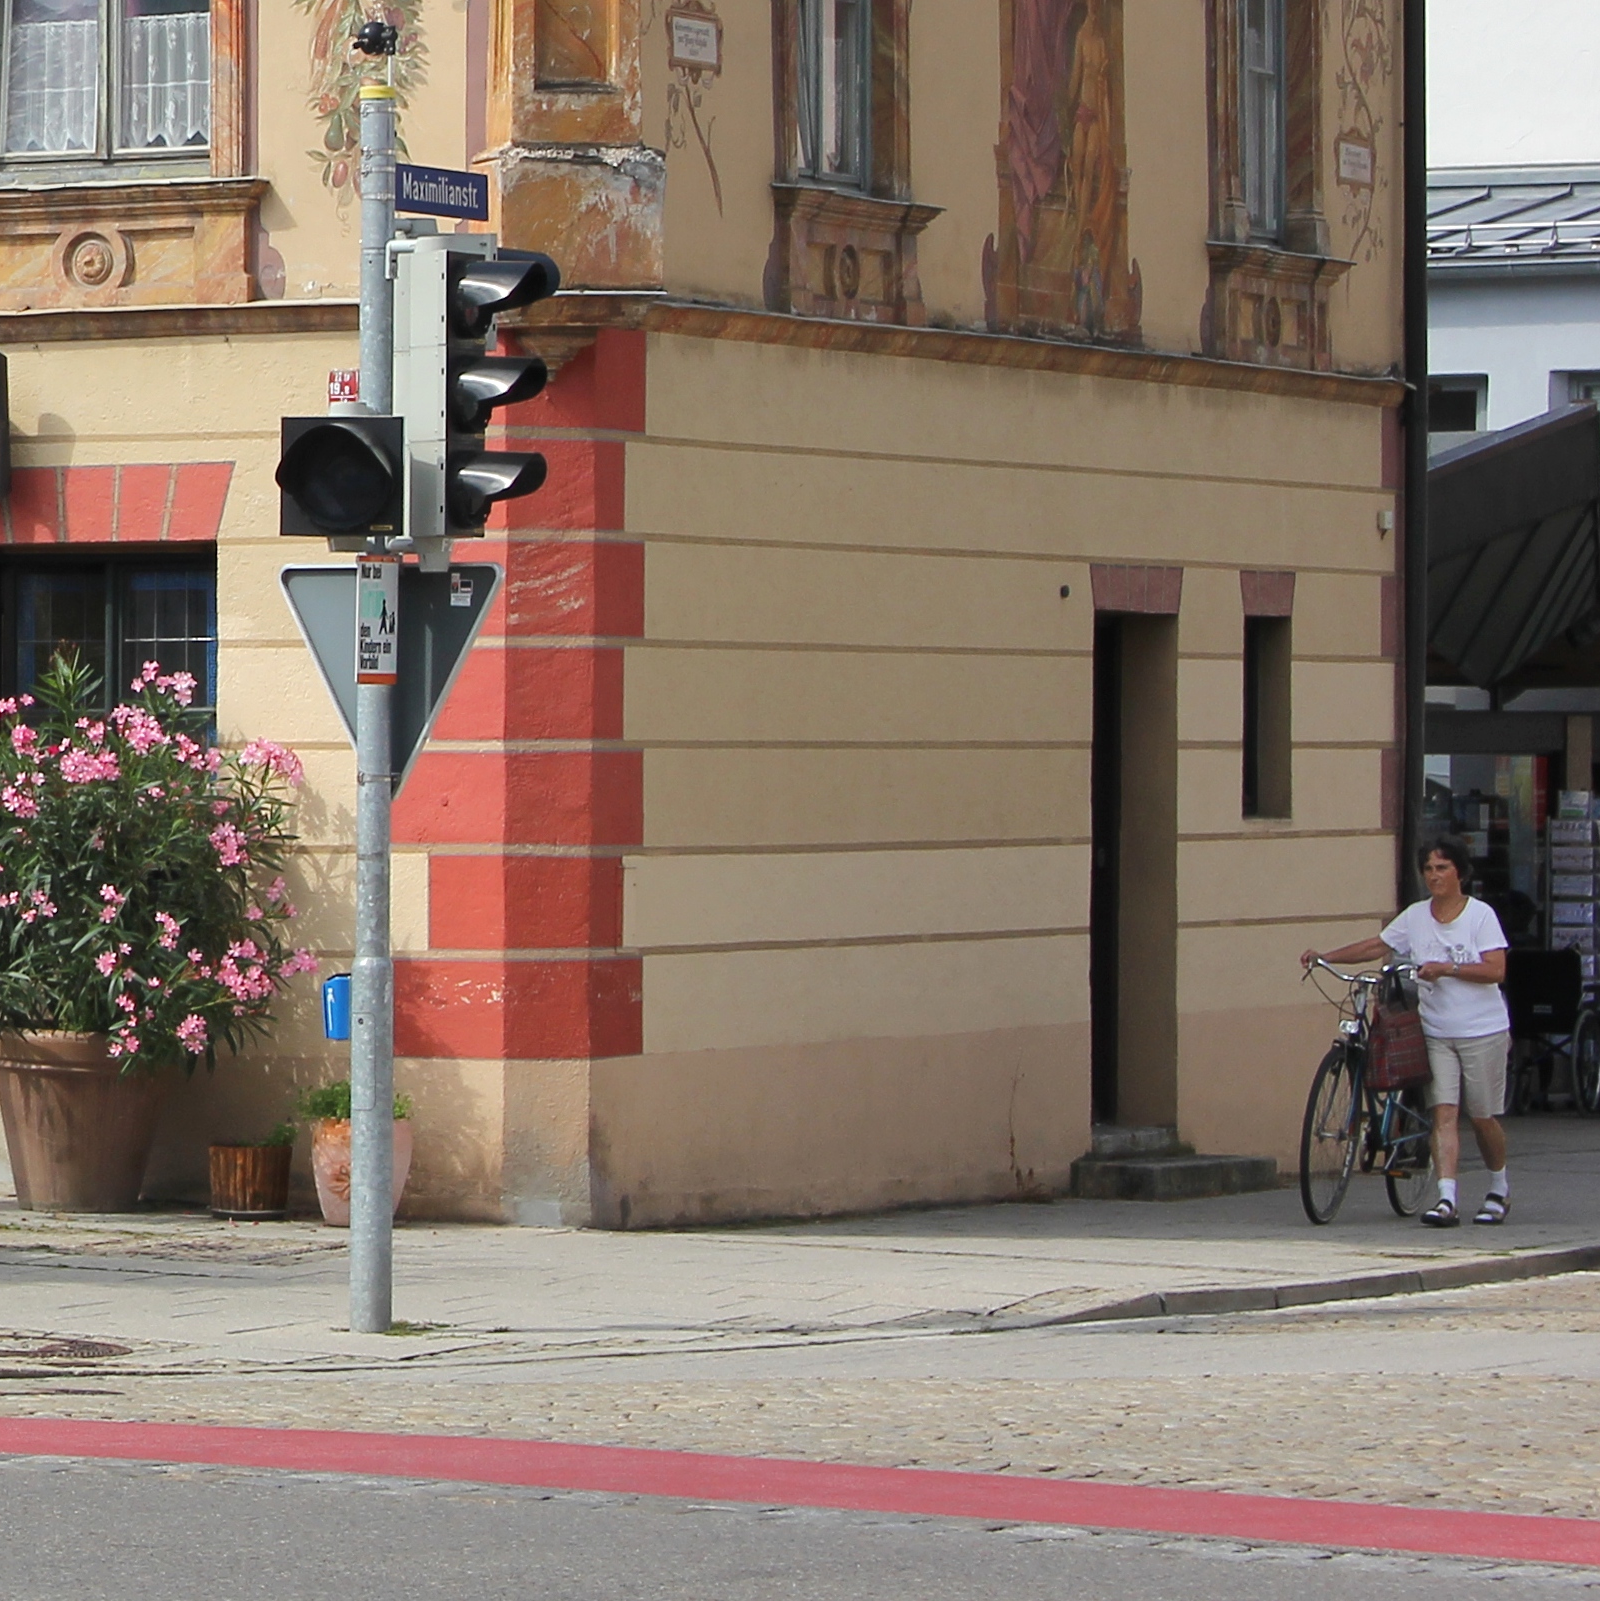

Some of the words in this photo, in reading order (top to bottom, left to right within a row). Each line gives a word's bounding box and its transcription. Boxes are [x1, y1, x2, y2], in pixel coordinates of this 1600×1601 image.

[402, 170, 479, 209] Maximilianstr.
[361, 563, 372, 579] Nur
[372, 563, 383, 579] bei
[360, 622, 371, 638] den
[359, 639, 382, 654] Kindern
[382, 639, 392, 654] ein
[360, 654, 379, 670] Vorbild
